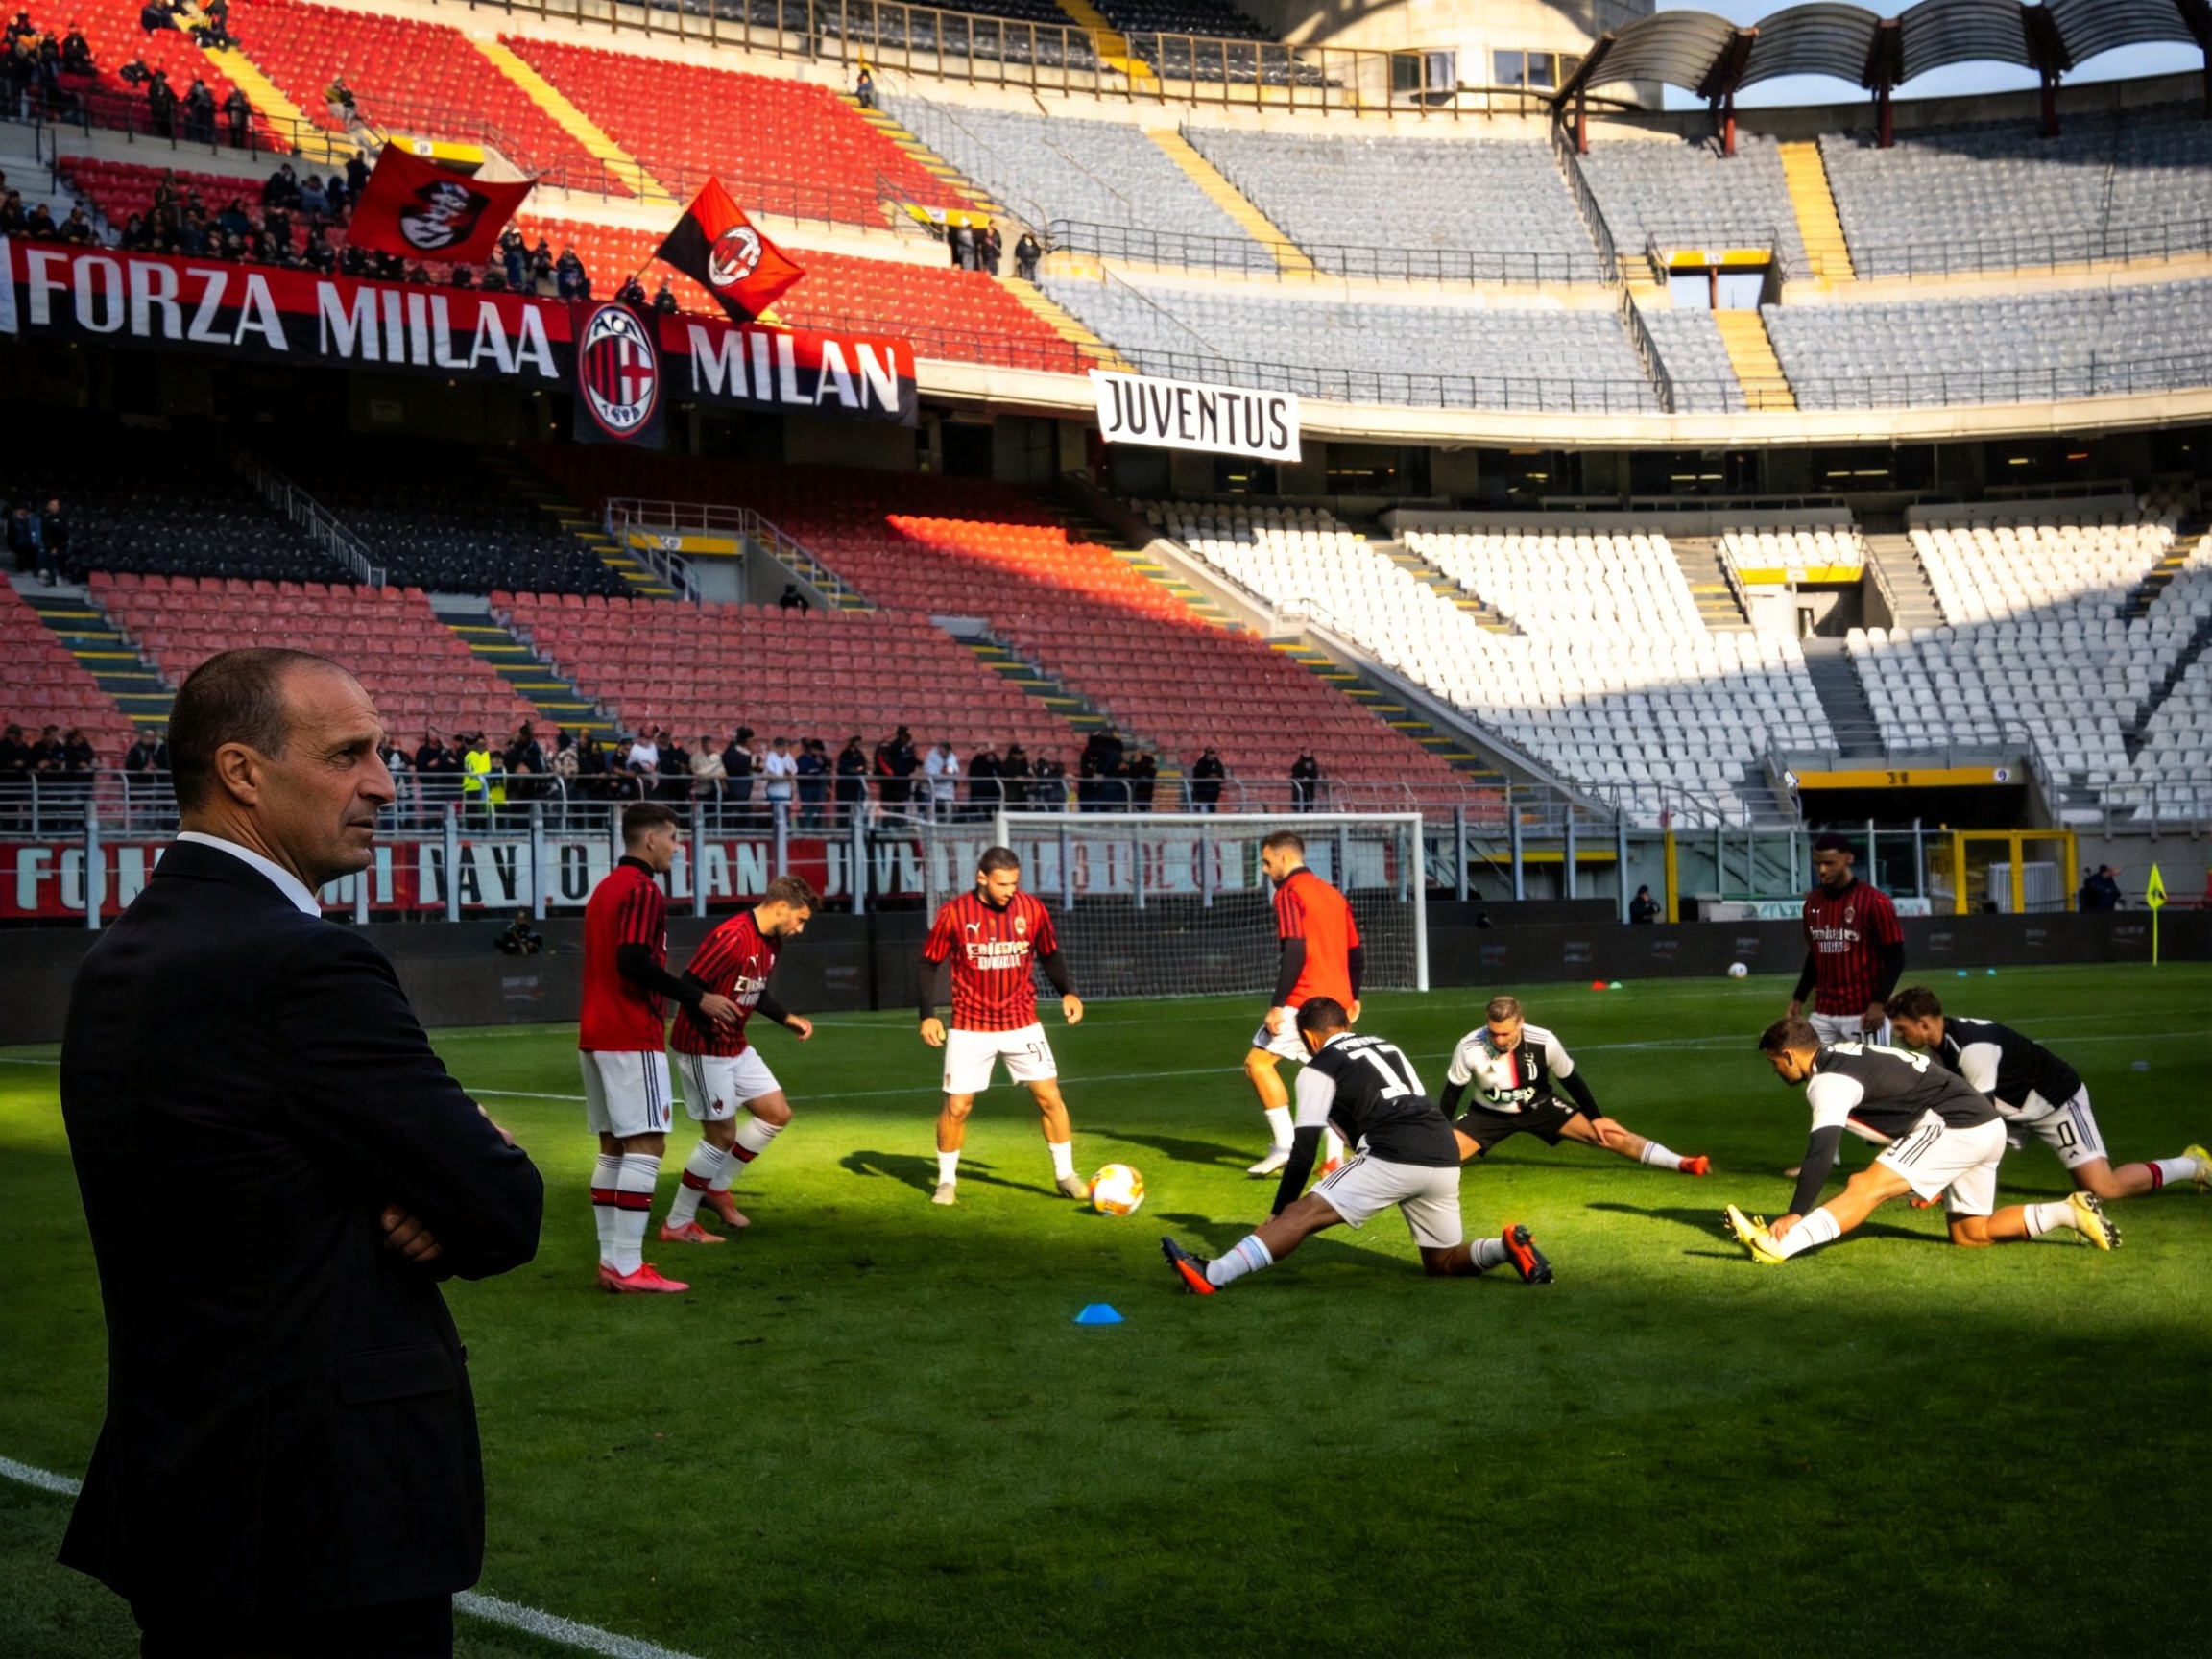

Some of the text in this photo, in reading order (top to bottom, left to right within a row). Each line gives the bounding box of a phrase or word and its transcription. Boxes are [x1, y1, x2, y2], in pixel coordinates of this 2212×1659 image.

[26, 249, 289, 350] FORZA
[687, 323, 900, 413] MILAN
[1107, 379, 1289, 451] JUVENTUS
[1347, 1044, 1427, 1100] 17
